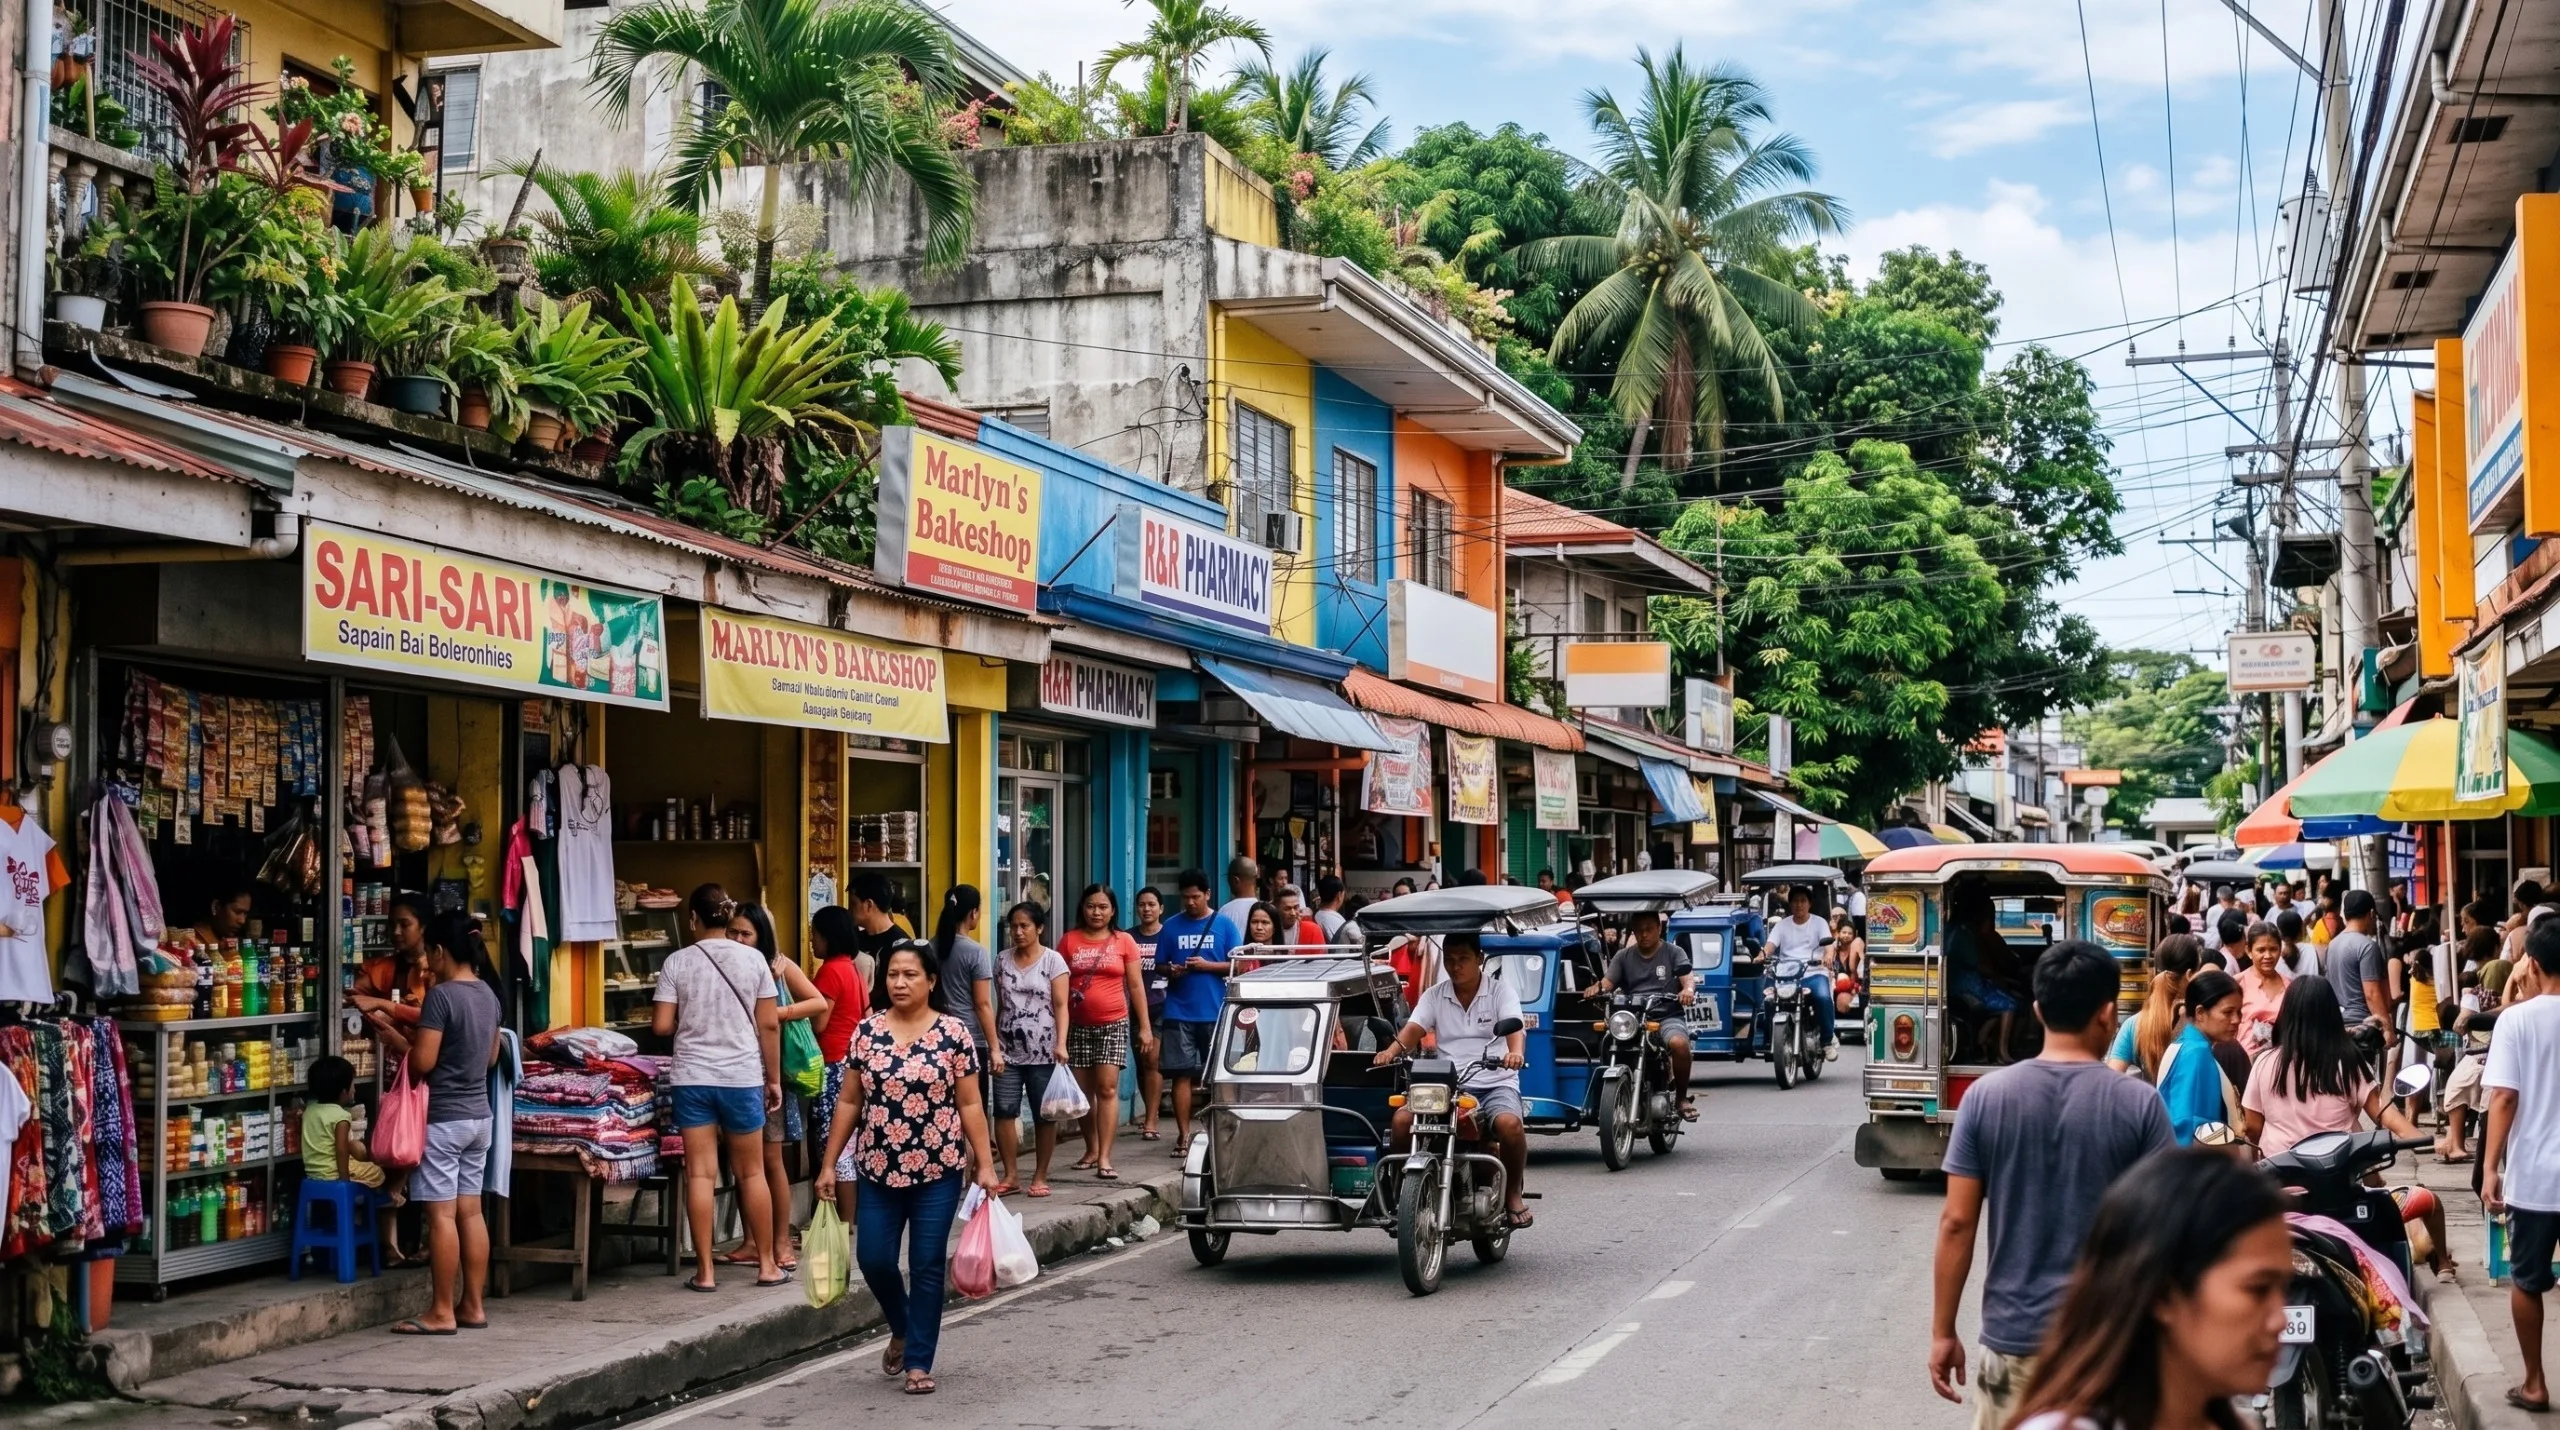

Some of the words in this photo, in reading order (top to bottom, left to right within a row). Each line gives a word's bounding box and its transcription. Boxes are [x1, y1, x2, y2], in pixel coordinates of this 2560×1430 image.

[924, 445, 1029, 514] Marlyn's
[915, 497, 1032, 573] Bakeshop
[1144, 519, 1180, 590] R&R
[1185, 533, 1269, 615] PHARMACY
[315, 540, 533, 642] SARI-SARI
[338, 619, 394, 653] Sapain
[400, 629, 424, 656] Bai
[429, 634, 513, 669] Boleronhies
[710, 618, 829, 675] MARLYN'S
[832, 641, 937, 693] BAKESHOP
[1076, 664, 1154, 720] PHARMACY
